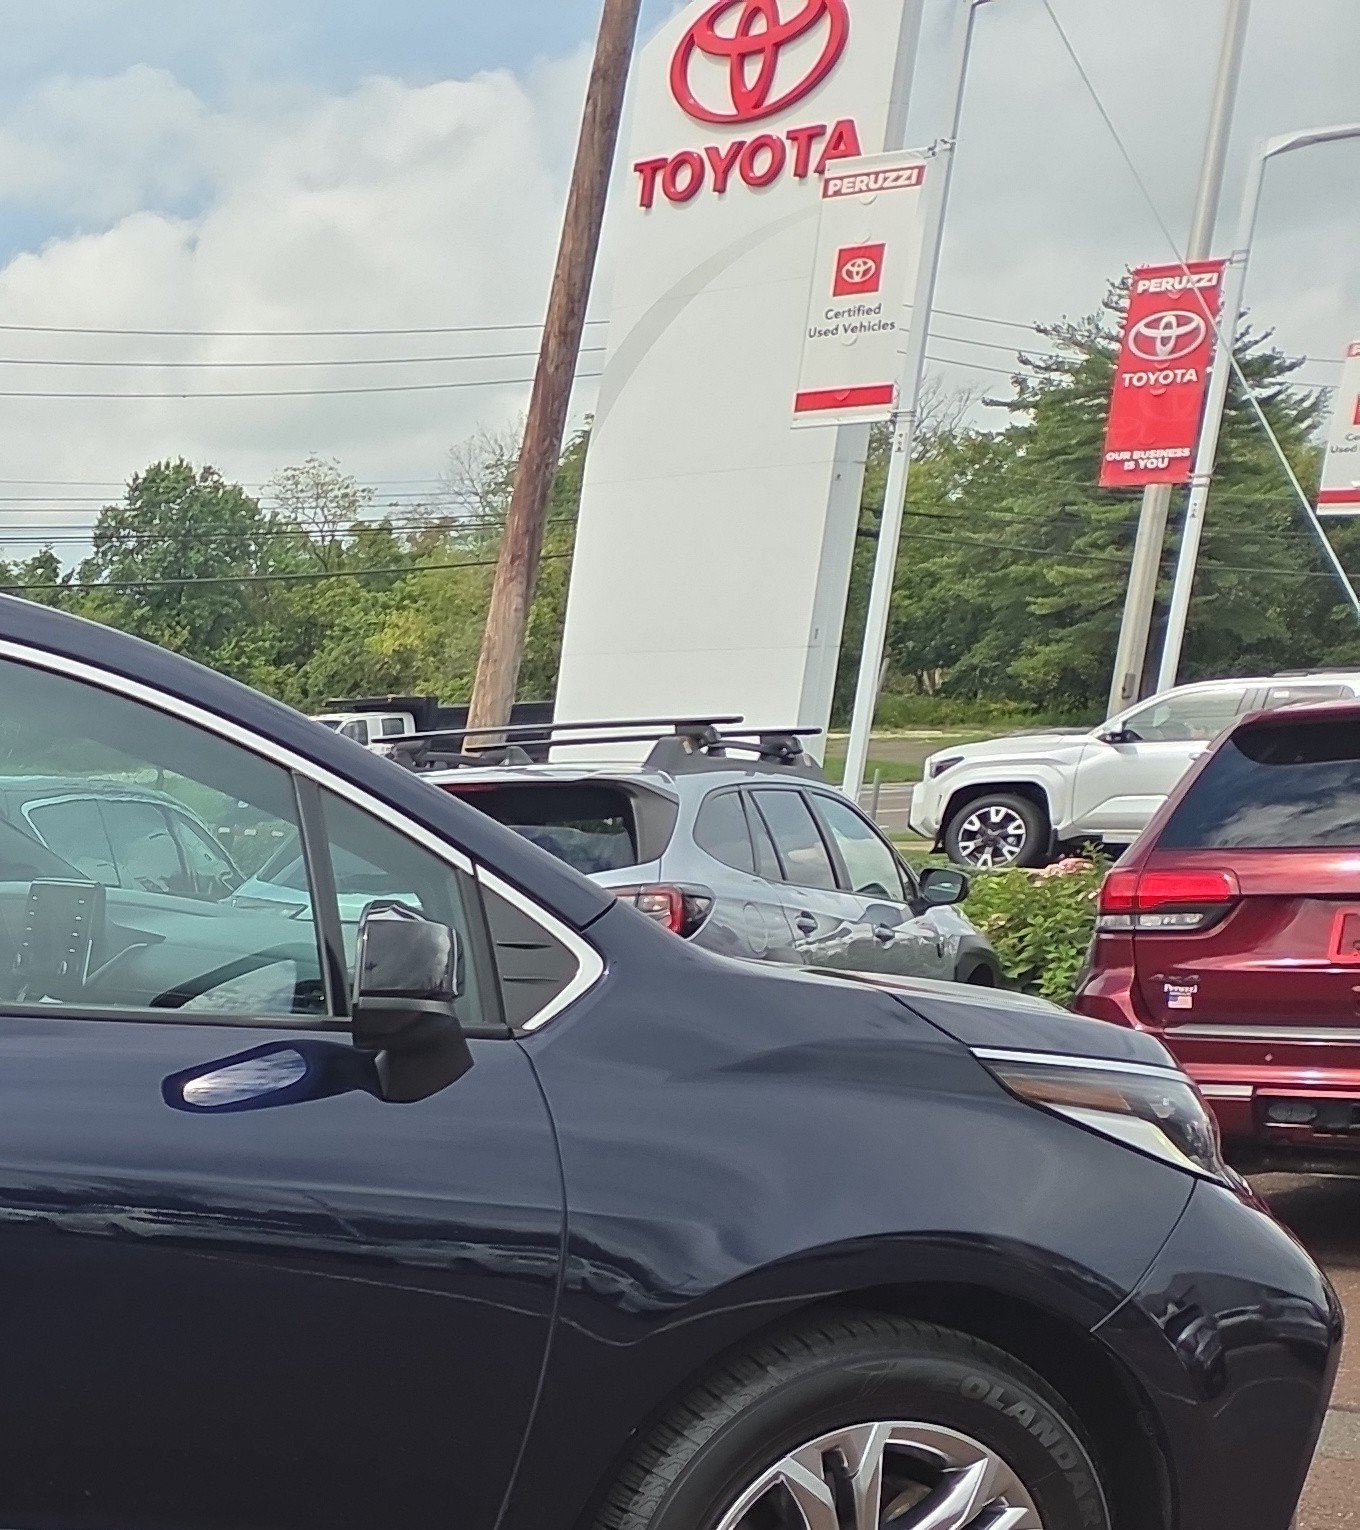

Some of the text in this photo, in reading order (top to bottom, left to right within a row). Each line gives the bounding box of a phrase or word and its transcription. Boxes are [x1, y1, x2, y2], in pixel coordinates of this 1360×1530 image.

[633, 119, 862, 208] TOYOTA
[827, 168, 918, 197] PERUZZI
[1137, 273, 1219, 294] PERUZZI
[825, 303, 882, 320] Certified
[808, 320, 895, 338] Used Vehicles
[1122, 369, 1198, 388] TOYOTA
[1105, 451, 1131, 461] OUR
[1138, 457, 1169, 470] YOU
[944, 1375, 1103, 1529] OLANDAR
